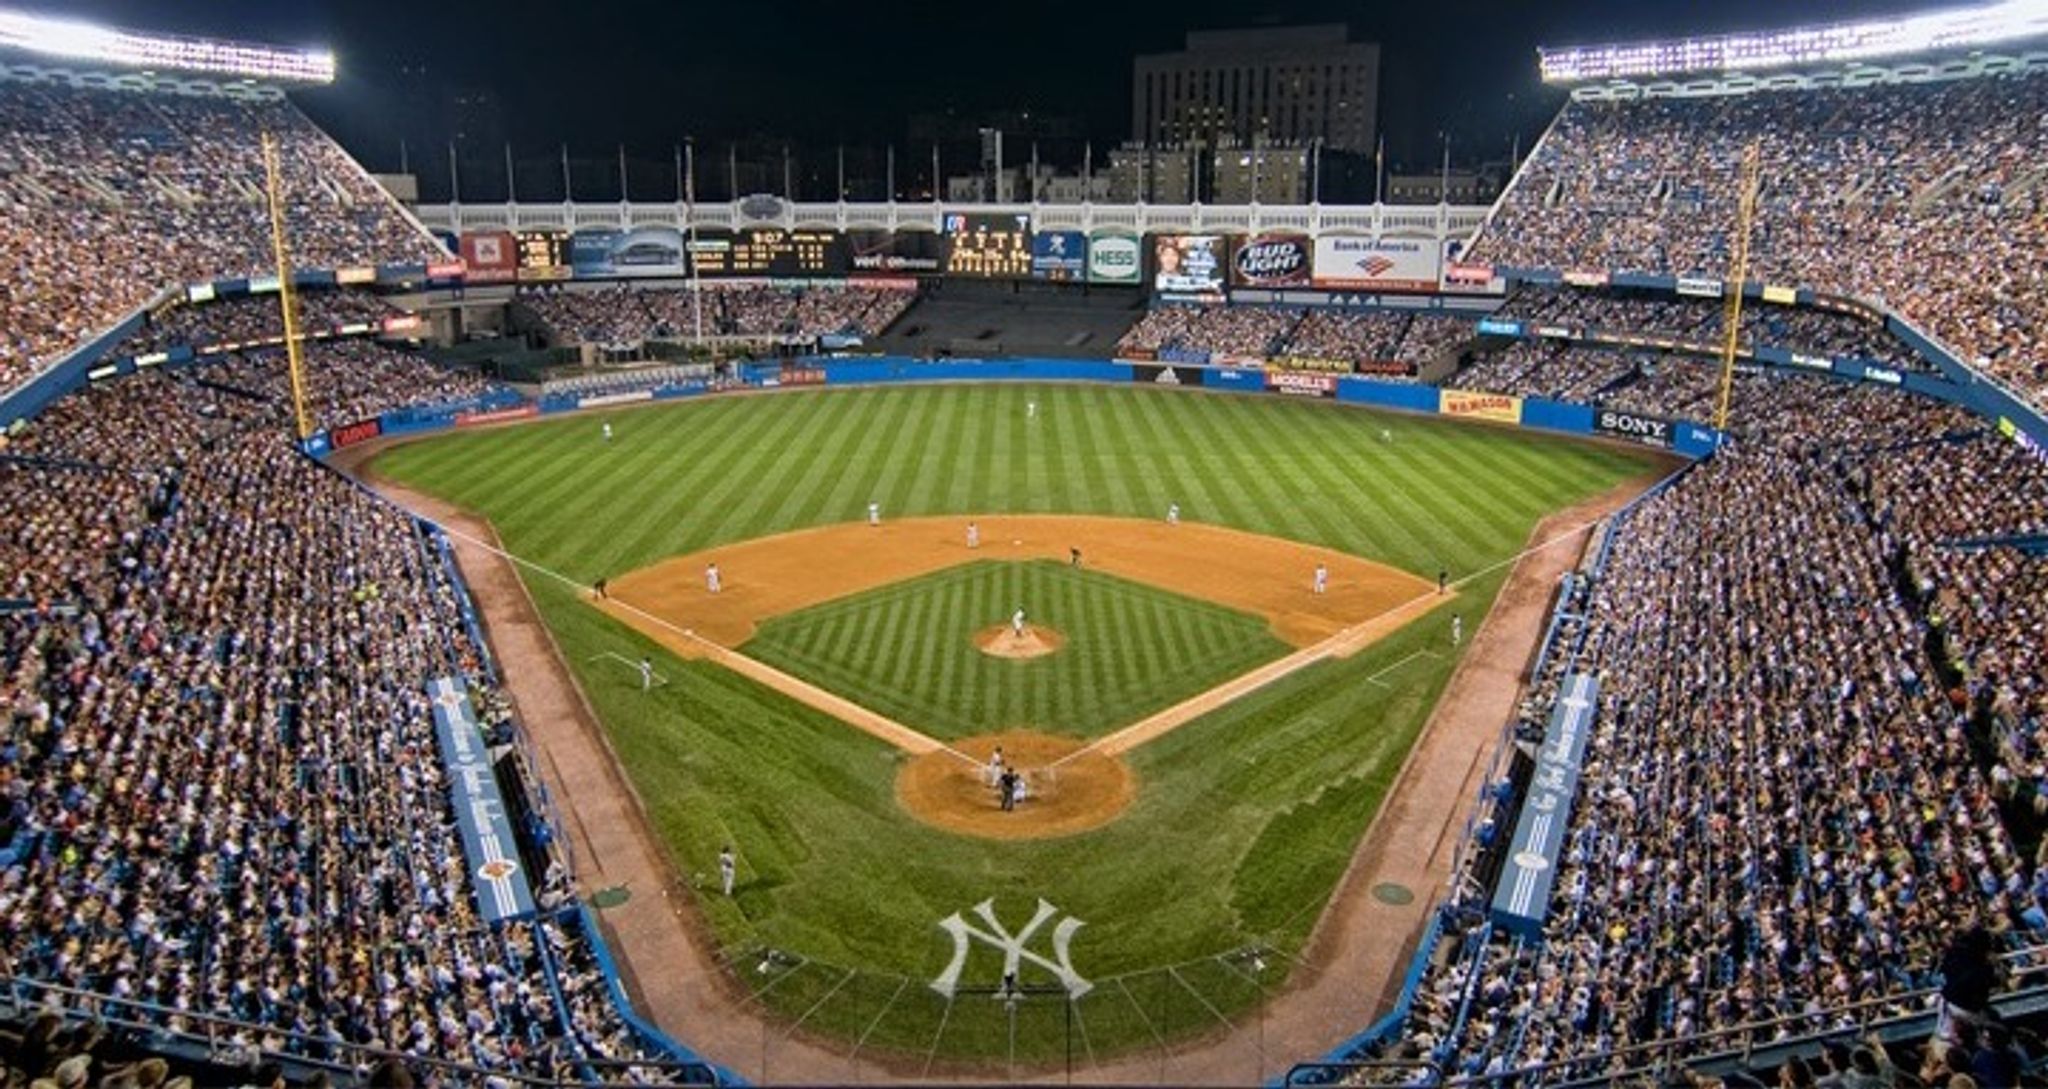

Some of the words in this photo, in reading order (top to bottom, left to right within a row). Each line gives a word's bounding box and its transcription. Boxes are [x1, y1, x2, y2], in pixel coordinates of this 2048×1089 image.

[1249, 242, 1296, 258] BUD
[1334, 240, 1363, 251] Bank
[1364, 240, 1374, 251] of
[1376, 240, 1419, 251] America
[1095, 250, 1134, 266] HESS
[1242, 254, 1301, 272] LIGHT
[1600, 412, 1666, 437] SONY
[929, 897, 1094, 1000] NY
